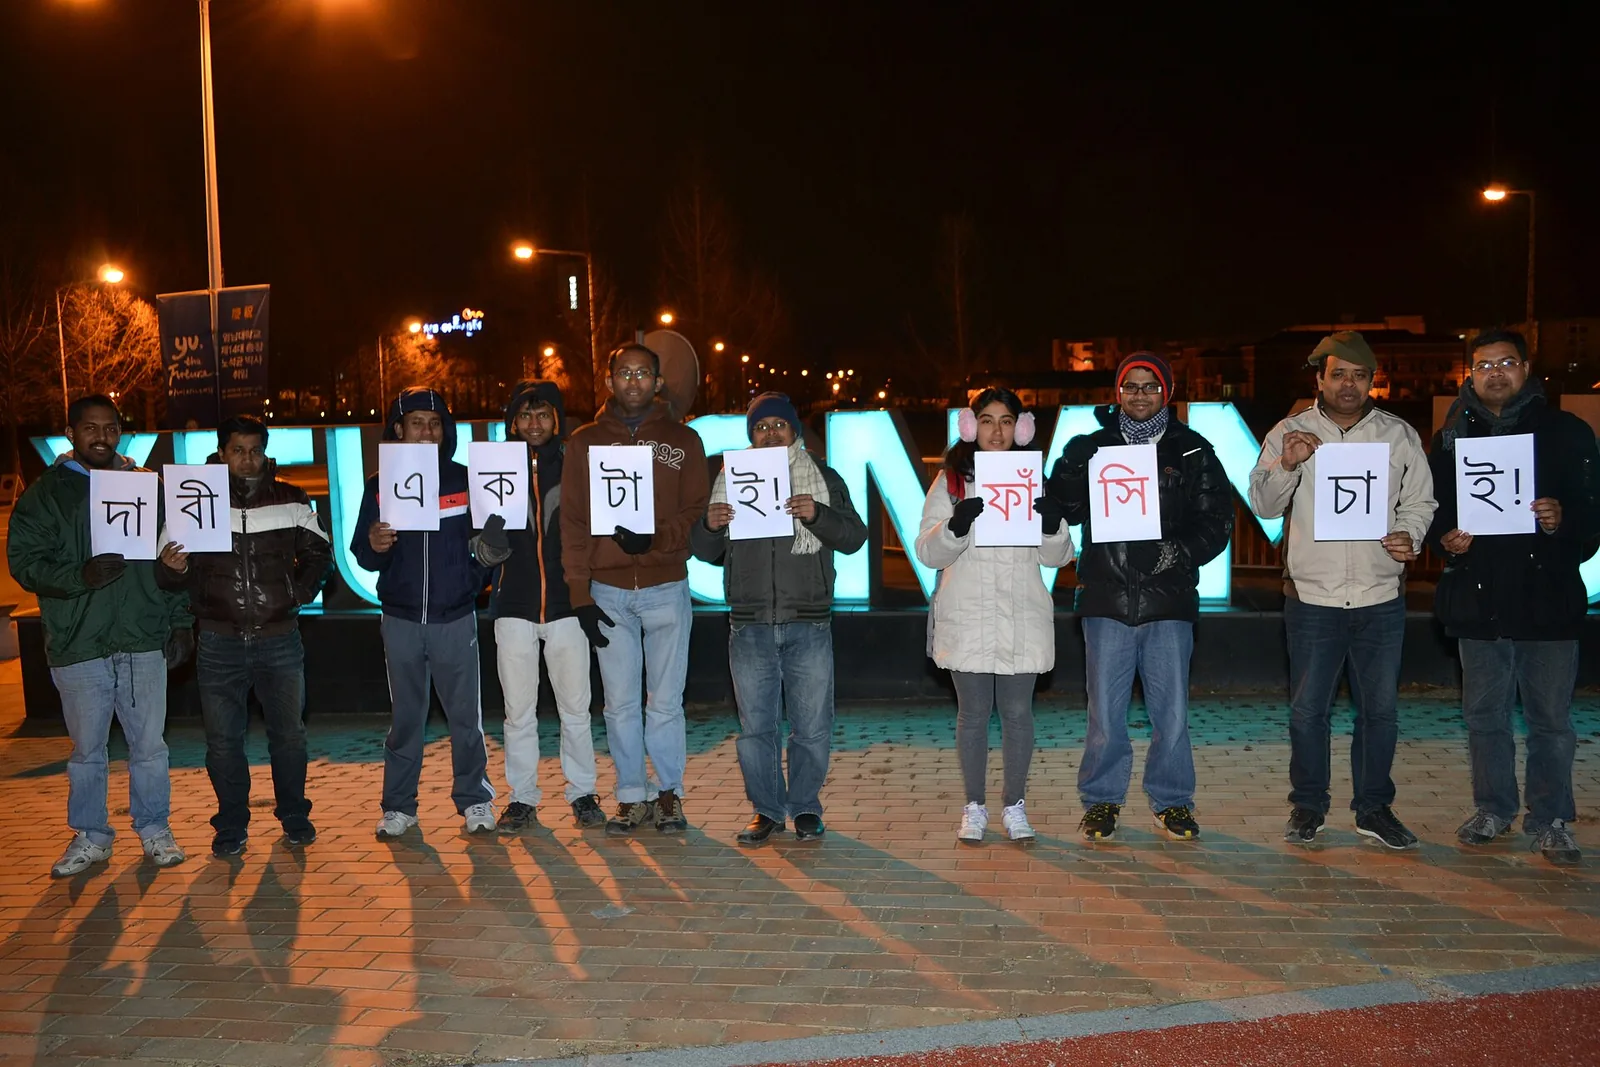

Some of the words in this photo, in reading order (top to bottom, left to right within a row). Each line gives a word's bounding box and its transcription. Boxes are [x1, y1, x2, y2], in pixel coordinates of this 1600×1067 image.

[637, 440, 685, 470] 892
[393, 472, 424, 508] এ
[477, 471, 518, 507] ক
